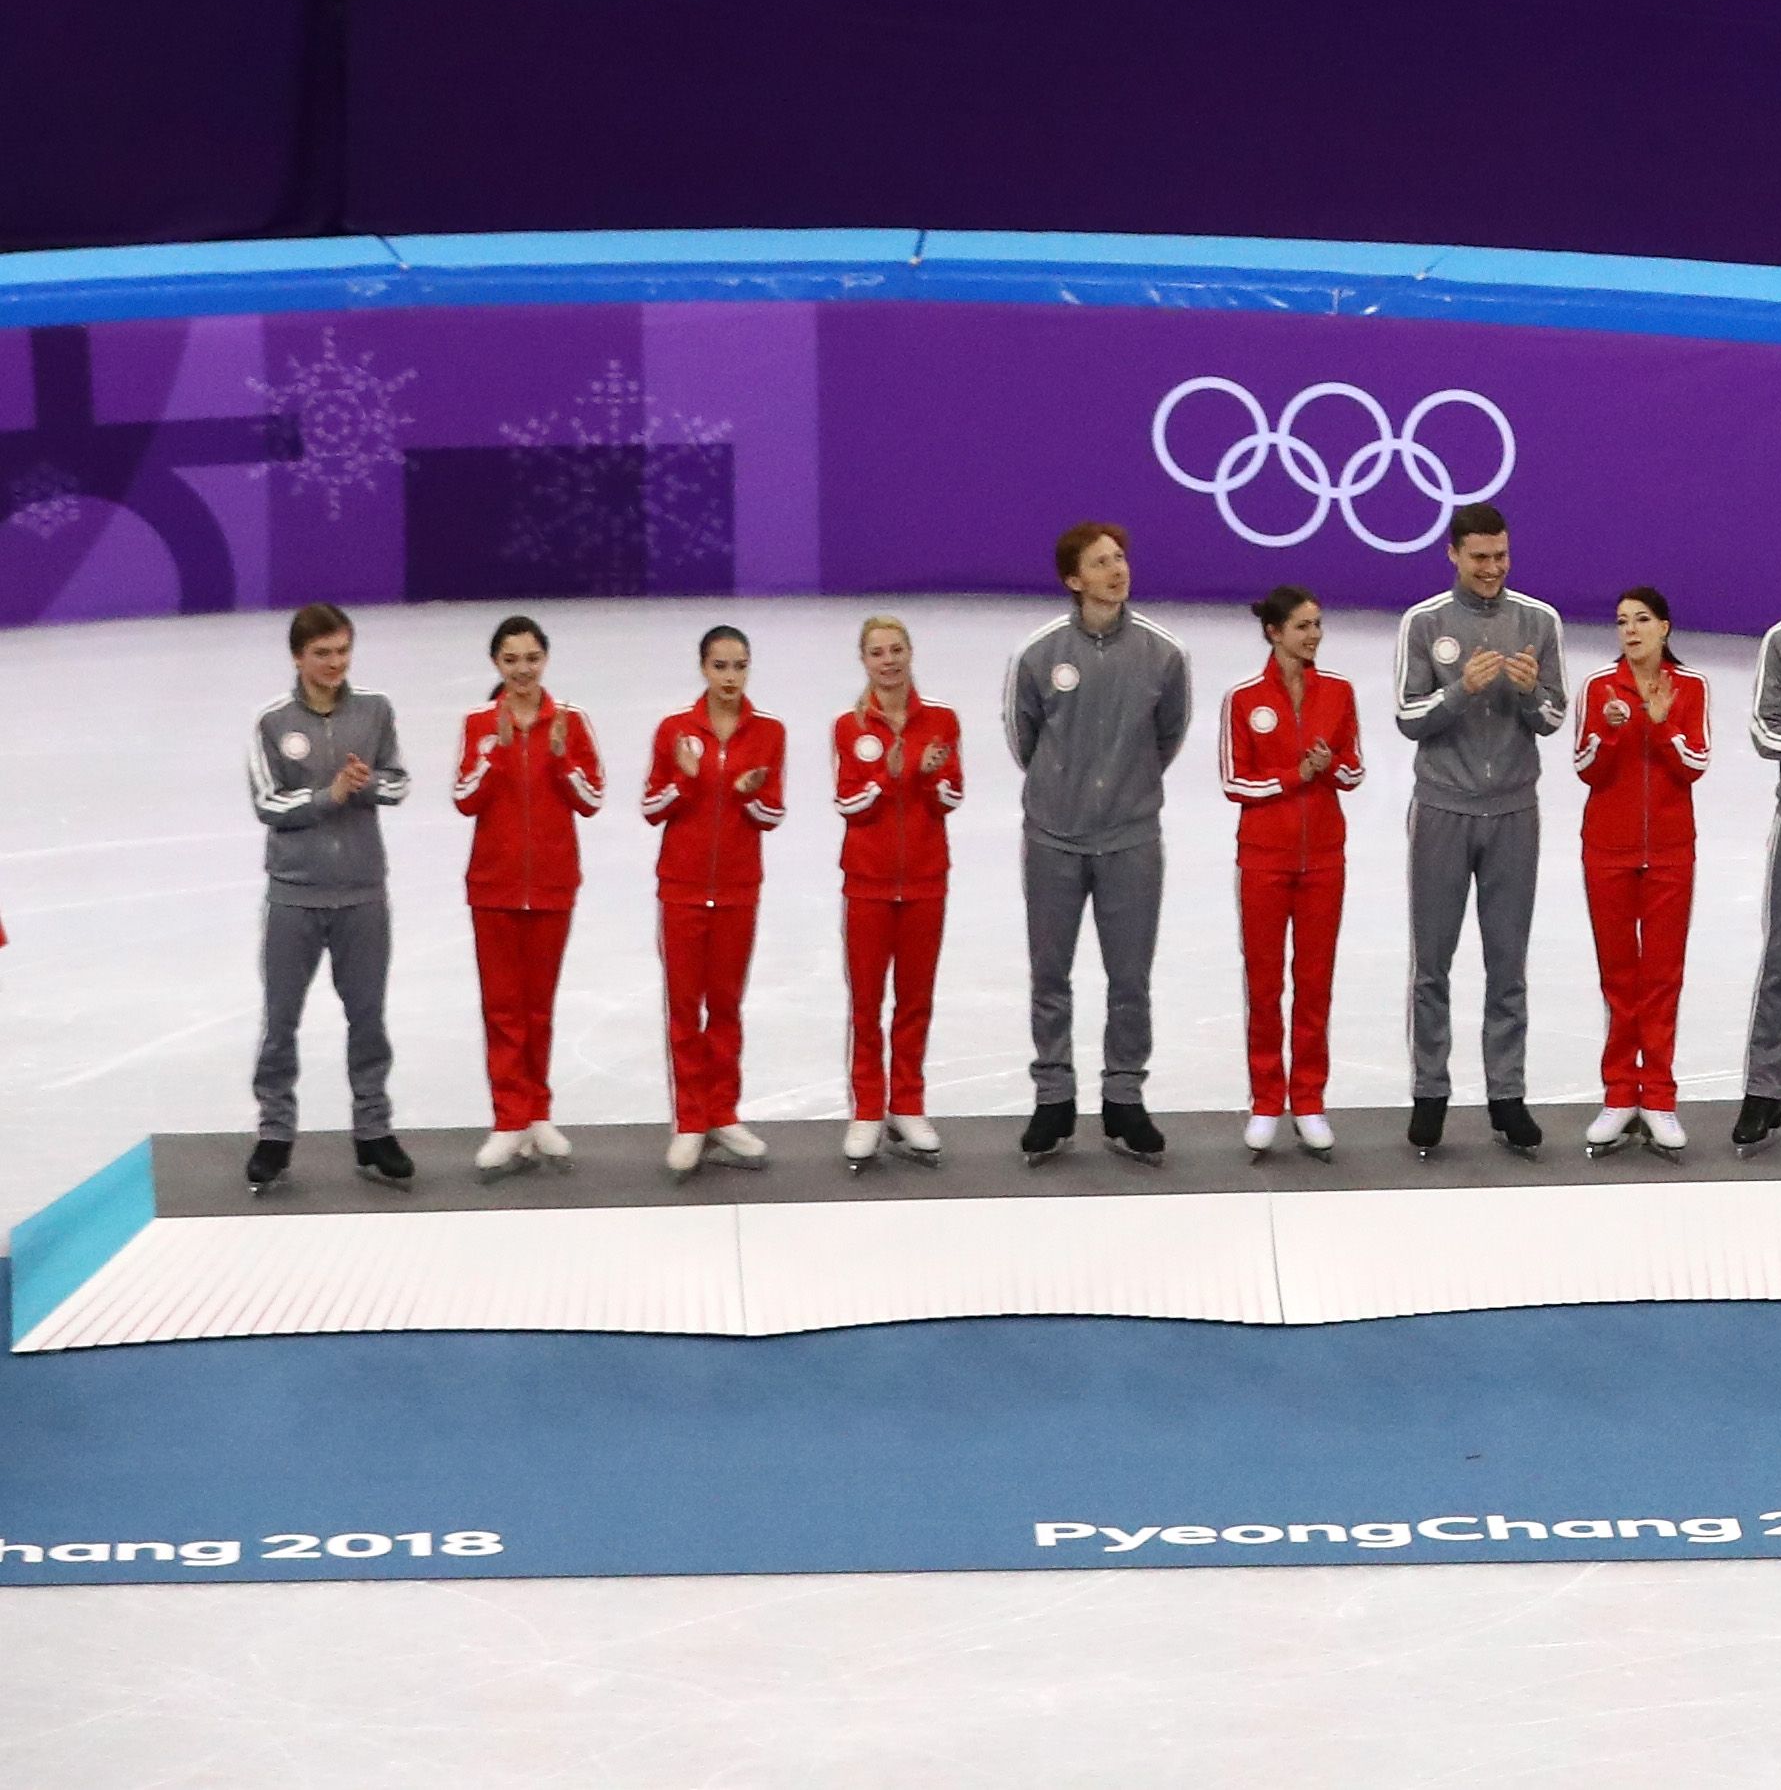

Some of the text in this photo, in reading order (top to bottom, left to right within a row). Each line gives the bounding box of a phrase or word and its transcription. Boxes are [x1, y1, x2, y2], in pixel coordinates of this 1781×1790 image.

[0, 1530, 504, 1567] hang 2018
[1034, 1514, 1742, 1552] PyeongChang
